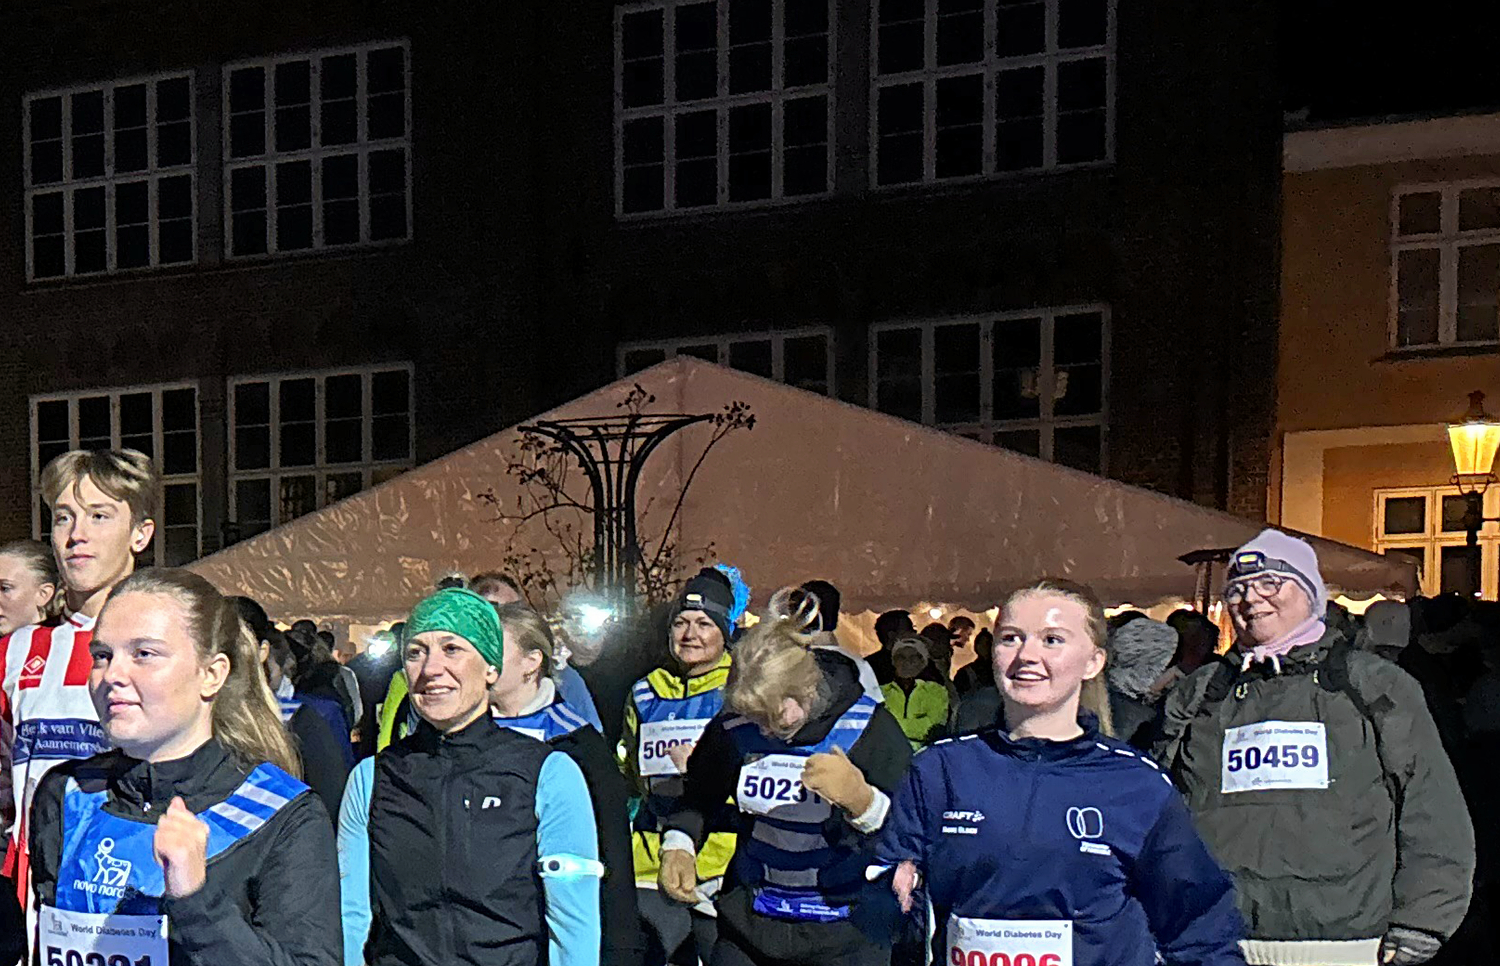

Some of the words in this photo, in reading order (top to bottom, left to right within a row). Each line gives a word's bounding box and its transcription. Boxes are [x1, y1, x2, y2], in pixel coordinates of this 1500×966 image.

[50, 723, 74, 735] van
[1227, 744, 1319, 772] 50459
[73, 880, 97, 894] novo
[98, 884, 126, 898] nord
[71, 923, 94, 934] World
[96, 926, 136, 937] Diabetes
[138, 927, 157, 939] Day
[975, 929, 1002, 938] World
[1003, 930, 1042, 938] Diabetes
[1044, 930, 1062, 940] Day
